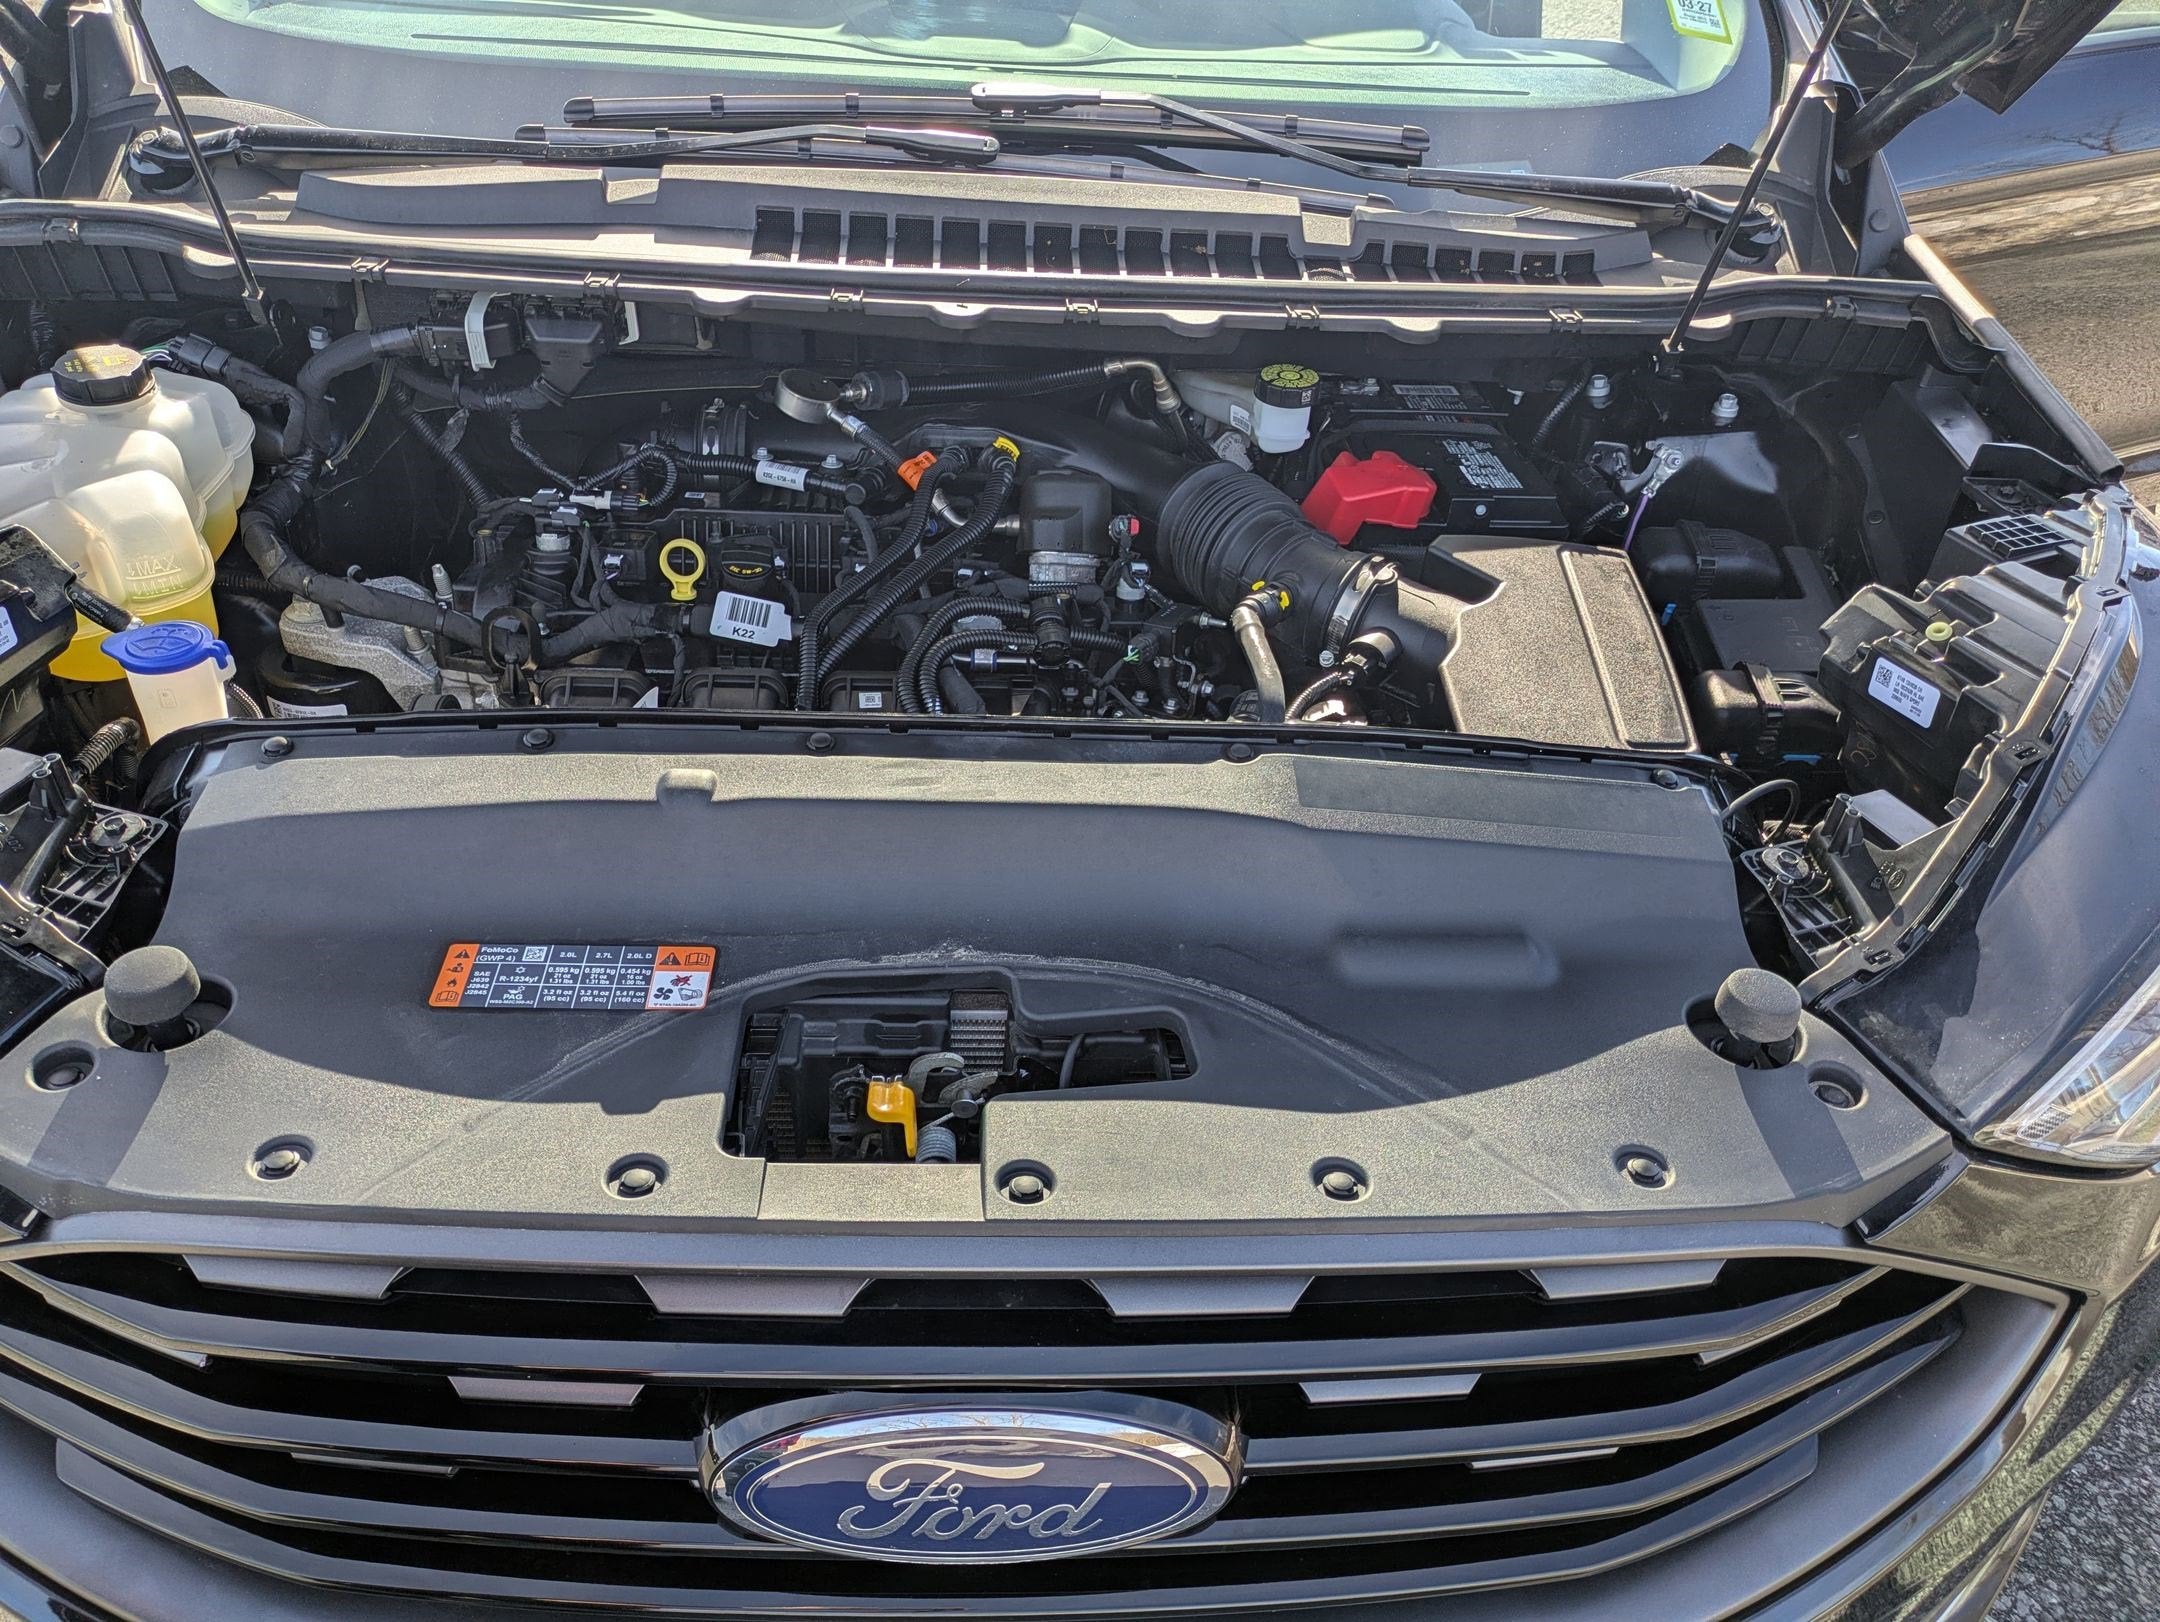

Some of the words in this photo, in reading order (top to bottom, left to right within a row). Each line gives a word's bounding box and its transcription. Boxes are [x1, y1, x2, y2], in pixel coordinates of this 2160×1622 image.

[136, 556, 178, 576] MAX
[732, 626, 756, 640] K22
[499, 976, 538, 984] R-1234yf
[836, 1457, 1112, 1541] Ford
